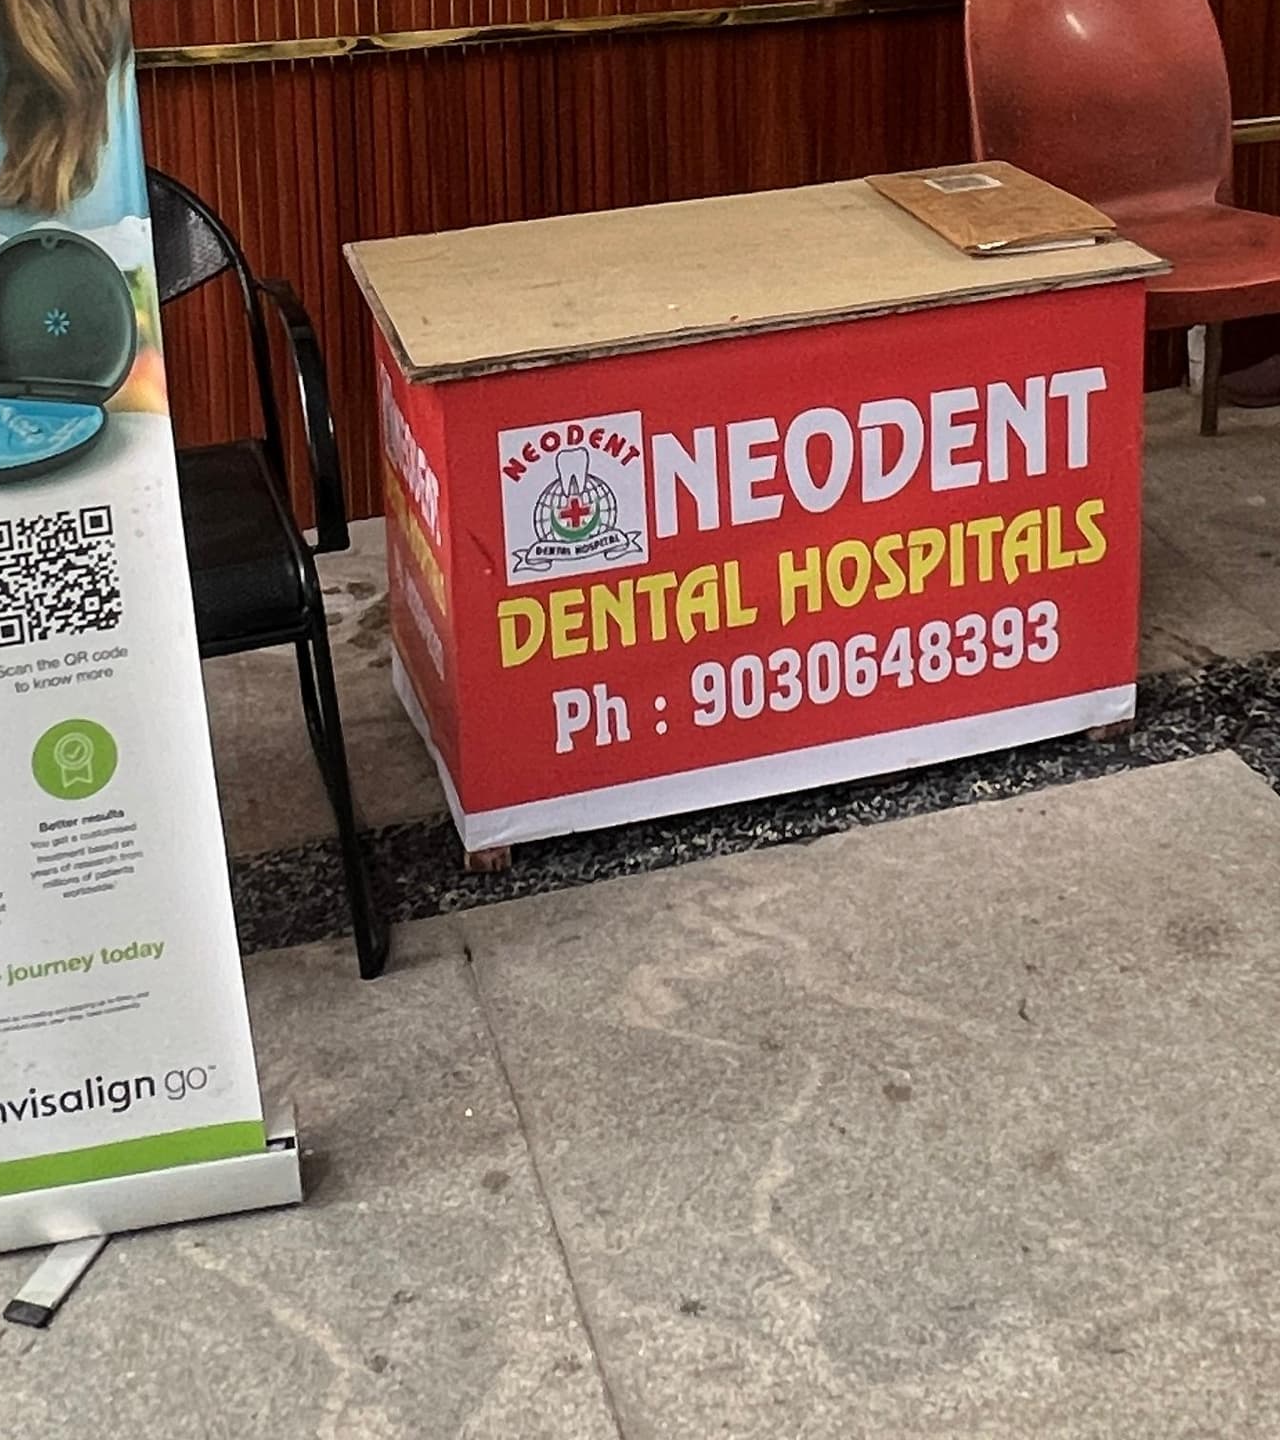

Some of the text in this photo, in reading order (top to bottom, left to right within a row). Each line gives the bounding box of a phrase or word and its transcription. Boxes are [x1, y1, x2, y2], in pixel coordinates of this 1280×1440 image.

[502, 424, 640, 482] NEODENT
[650, 366, 1108, 541] NEODENT
[497, 562, 759, 669] DENTAL
[777, 500, 1108, 627] HOSPITALS
[14, 667, 114, 693] to know more
[36, 658, 61, 672] the
[64, 651, 89, 666] QR
[92, 646, 128, 661] code
[552, 600, 1060, 754] Ph 9030648393
[6, 953, 95, 986] journey
[100, 939, 165, 968] today
